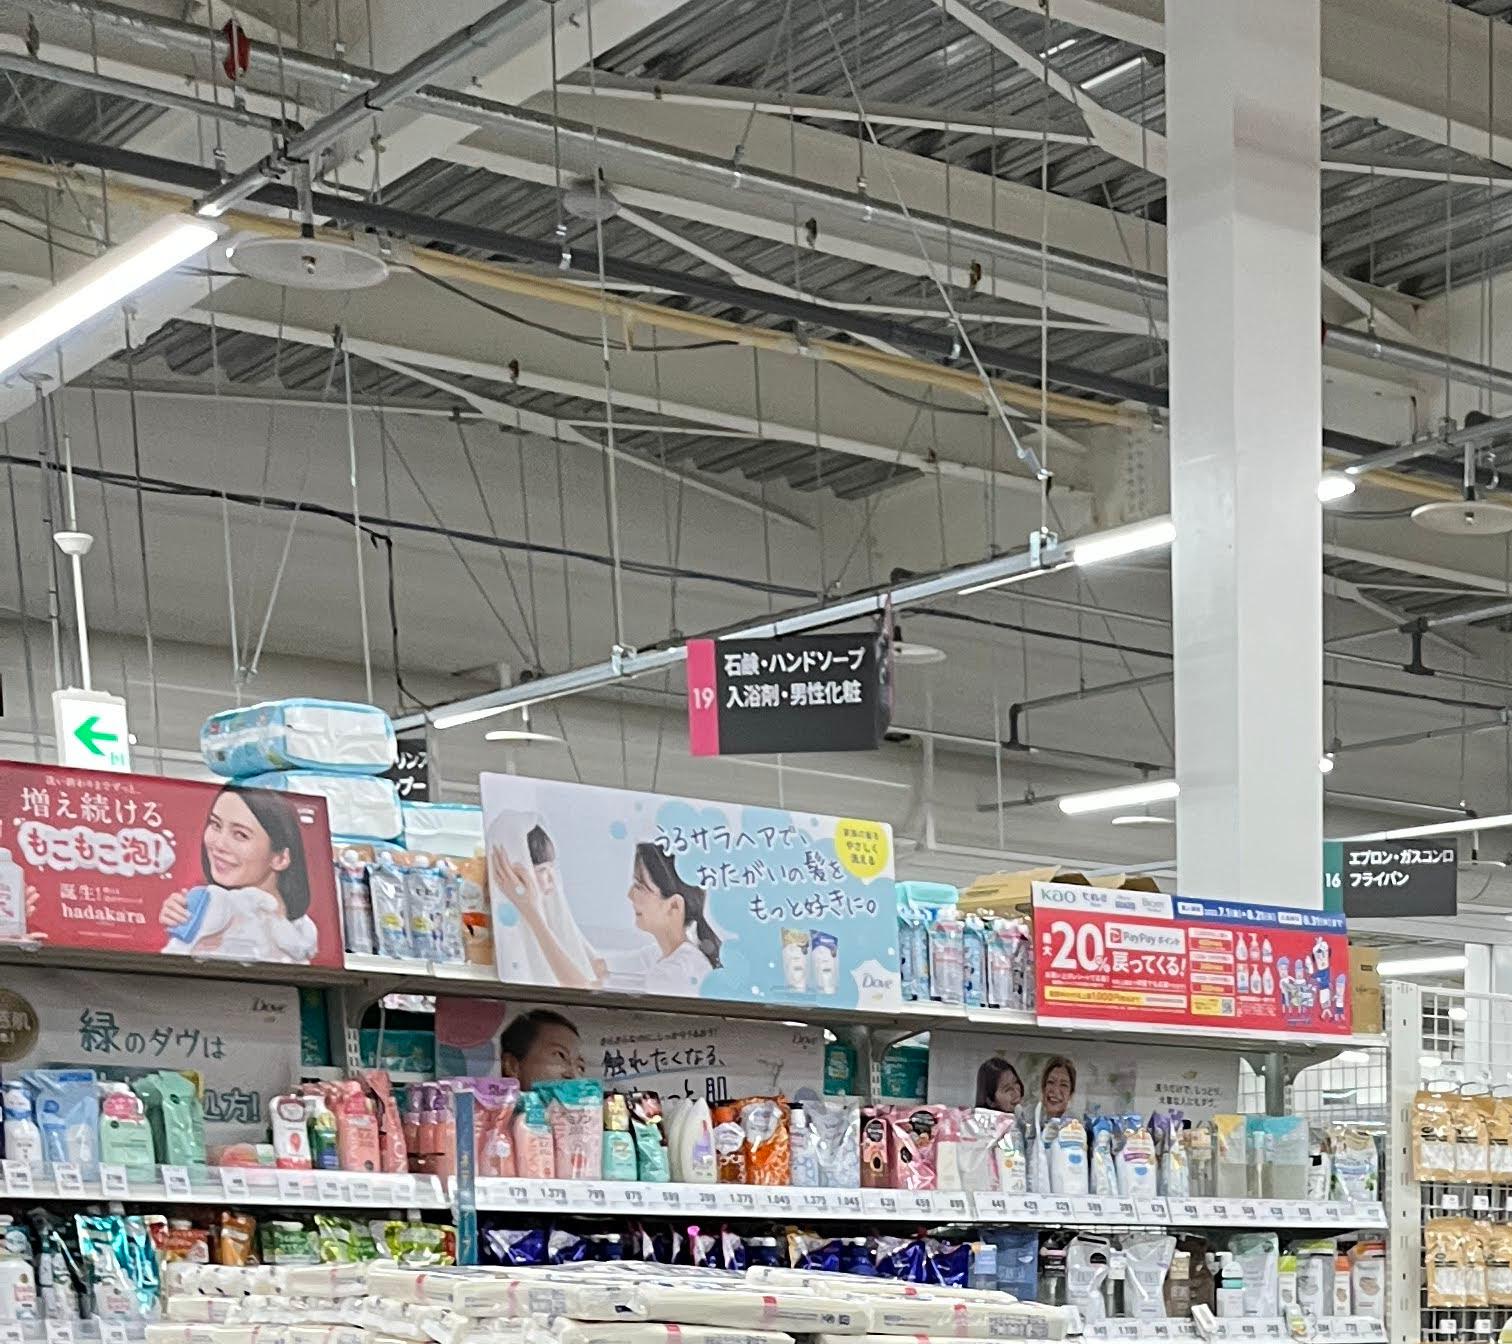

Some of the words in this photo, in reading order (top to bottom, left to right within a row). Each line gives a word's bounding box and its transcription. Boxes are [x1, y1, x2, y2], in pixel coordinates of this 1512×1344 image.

[724, 647, 865, 677] 石鹸・ハンドソープ
[693, 687, 715, 710] 19
[726, 679, 862, 708] 入浴剤・男性化粧
[21, 787, 163, 828] 増え続ける
[27, 828, 162, 870] もこもこ泡!
[1349, 849, 1454, 865] エプロン・ガスコンロ
[697, 851, 845, 888] おたがいの髪を
[1325, 873, 1341, 888] 16
[1349, 871, 1410, 887] フライパン
[62, 903, 147, 924] hadakara
[751, 889, 877, 920] もっと好きに。
[1124, 931, 1156, 945] PayPay
[1112, 951, 1186, 976] 戻ってくる!
[862, 973, 894, 989] Dove
[79, 1007, 227, 1059] 緑のダヴは
